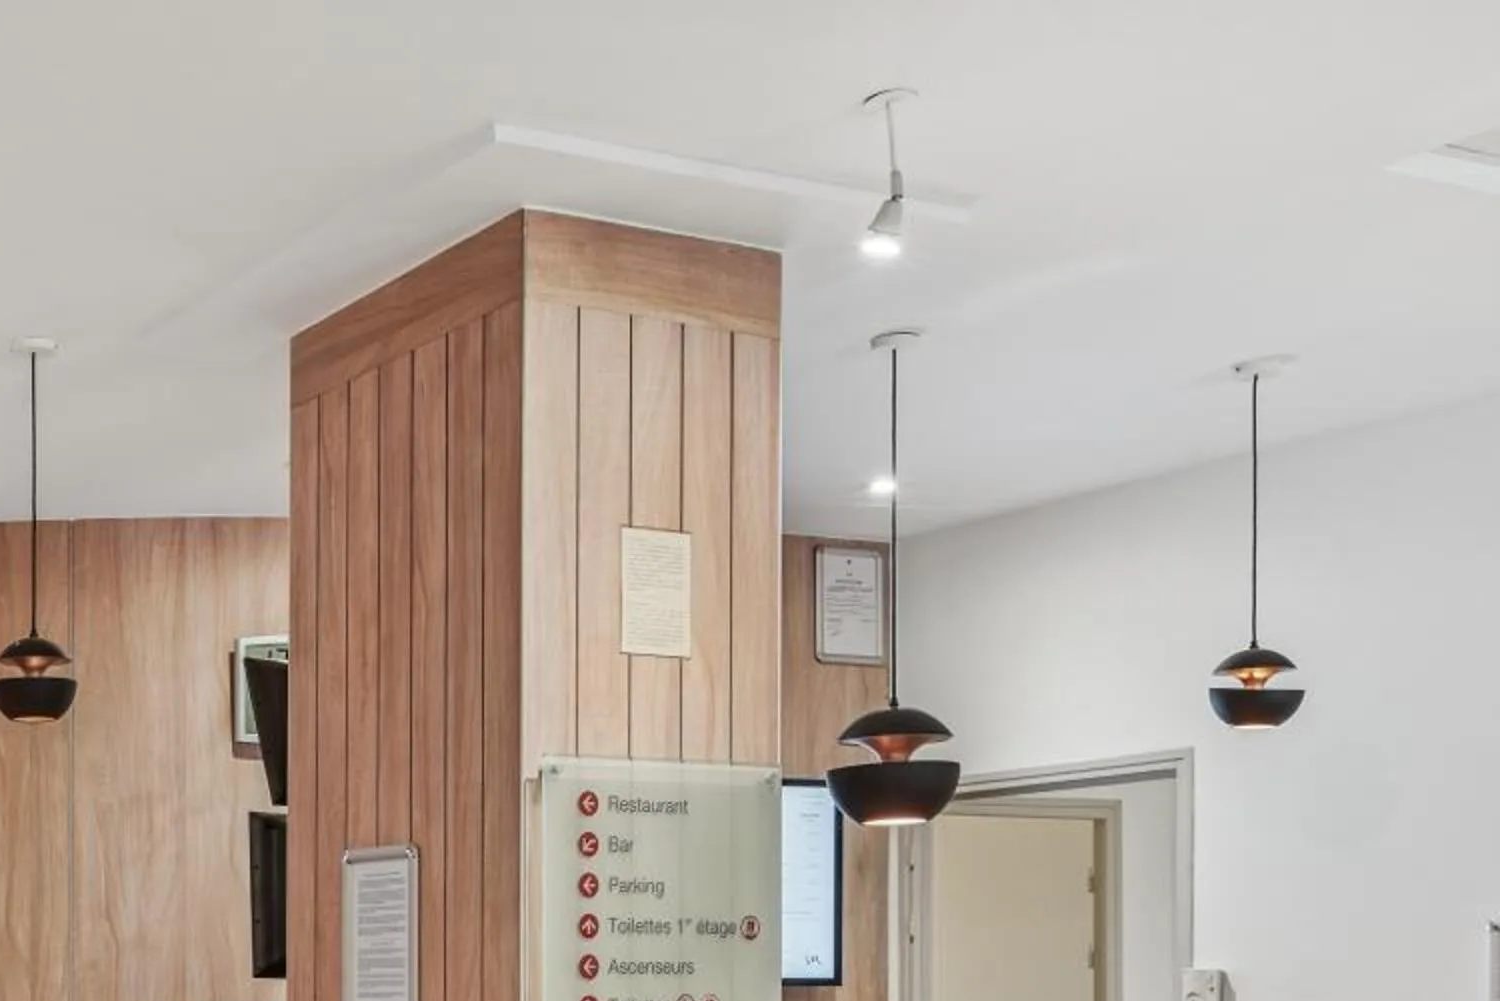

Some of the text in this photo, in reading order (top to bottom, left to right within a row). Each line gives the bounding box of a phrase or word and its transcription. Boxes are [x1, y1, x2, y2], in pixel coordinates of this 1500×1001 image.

[608, 795, 689, 815] Restaurant
[608, 835, 634, 853] Bar
[608, 876, 665, 897] Parking
[608, 917, 671, 935] Toilettes
[696, 917, 737, 938] étage
[608, 959, 695, 975] Ascenseurs
